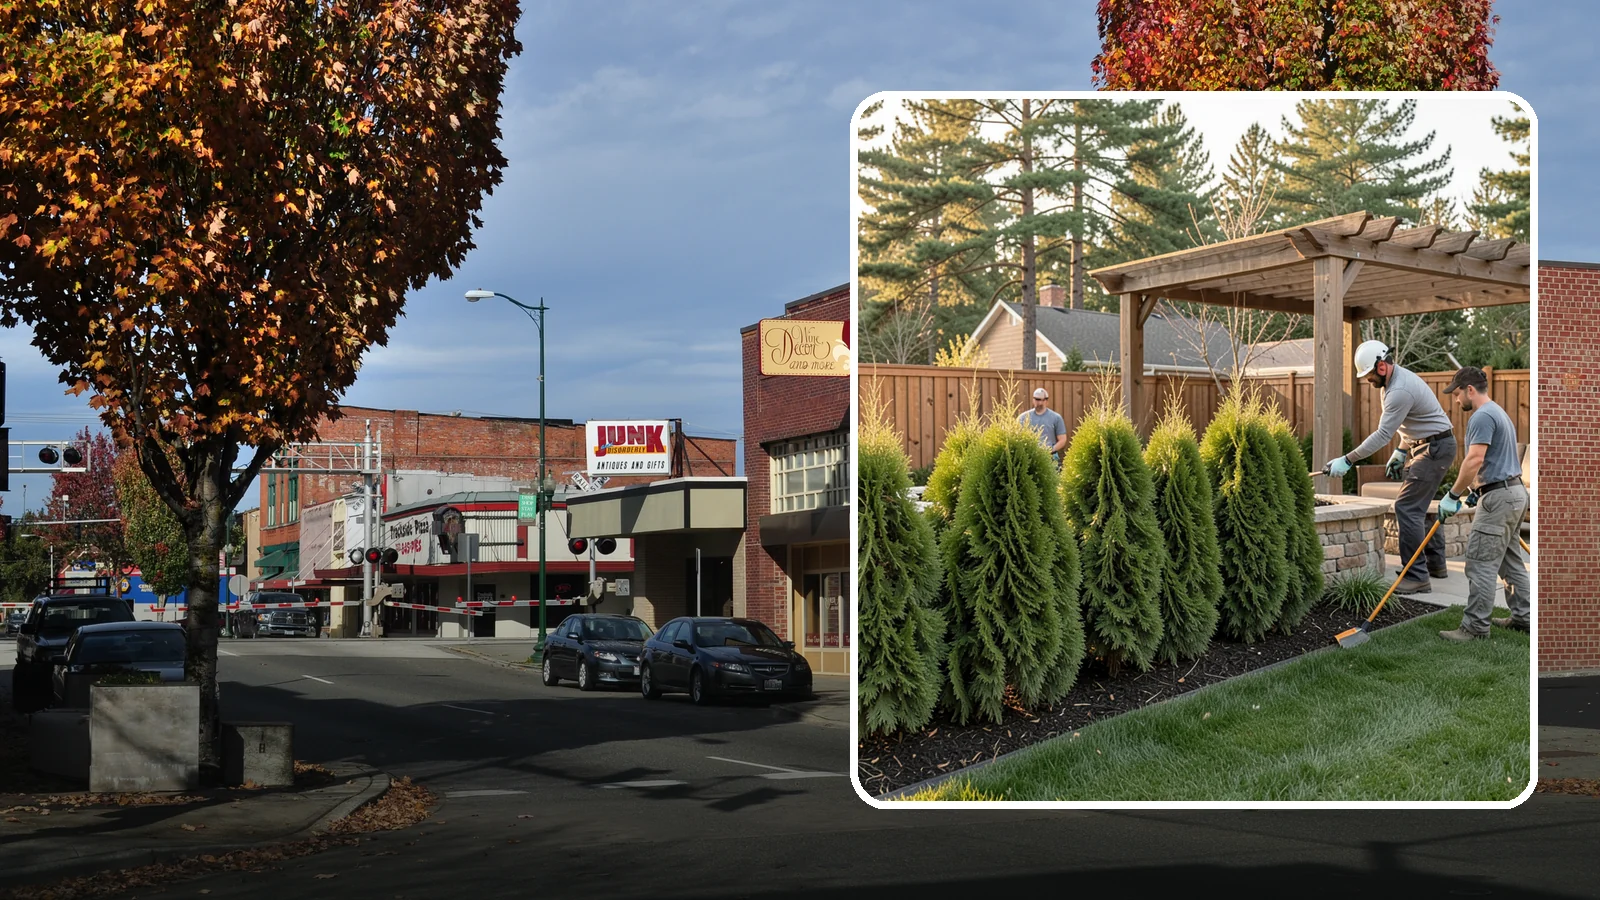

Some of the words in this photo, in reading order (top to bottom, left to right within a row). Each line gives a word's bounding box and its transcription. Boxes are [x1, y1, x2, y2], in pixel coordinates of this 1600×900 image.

[595, 425, 665, 457] JUNK
[607, 446, 646, 454] DISORDERLY
[597, 461, 628, 470] ANTIQUES
[631, 461, 644, 470] AND
[647, 460, 665, 469] GIFTS
